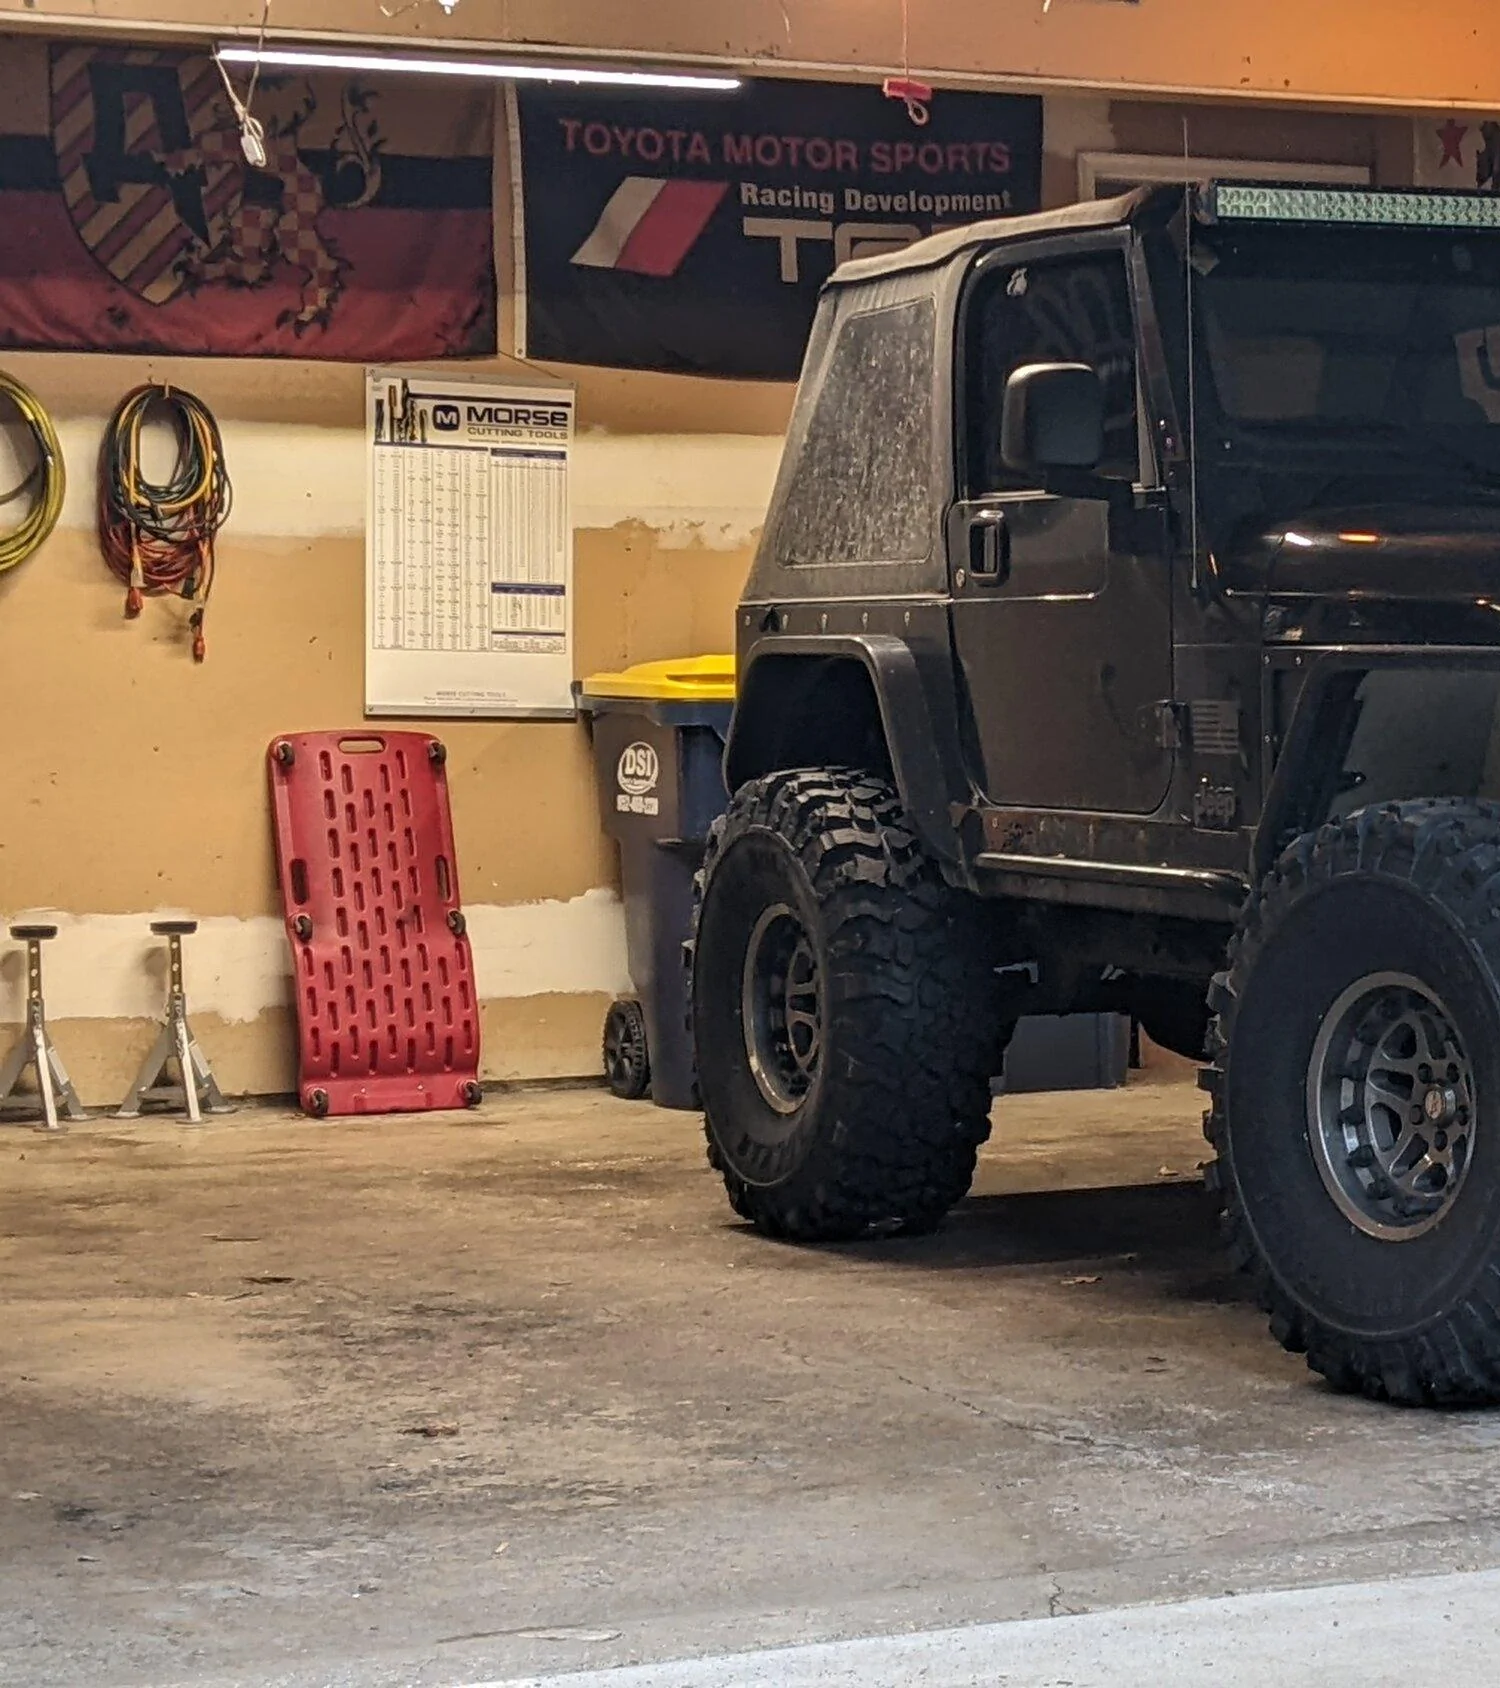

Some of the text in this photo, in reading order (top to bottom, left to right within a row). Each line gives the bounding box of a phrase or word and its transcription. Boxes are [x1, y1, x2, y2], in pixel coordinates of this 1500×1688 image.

[559, 118, 1011, 173] TOYOTA MOTOR SPORTS
[740, 182, 1012, 216] Racing Development
[467, 406, 568, 427] MORSE
[467, 427, 568, 440] CUTTING TOOLS
[625, 748, 652, 776] DSI
